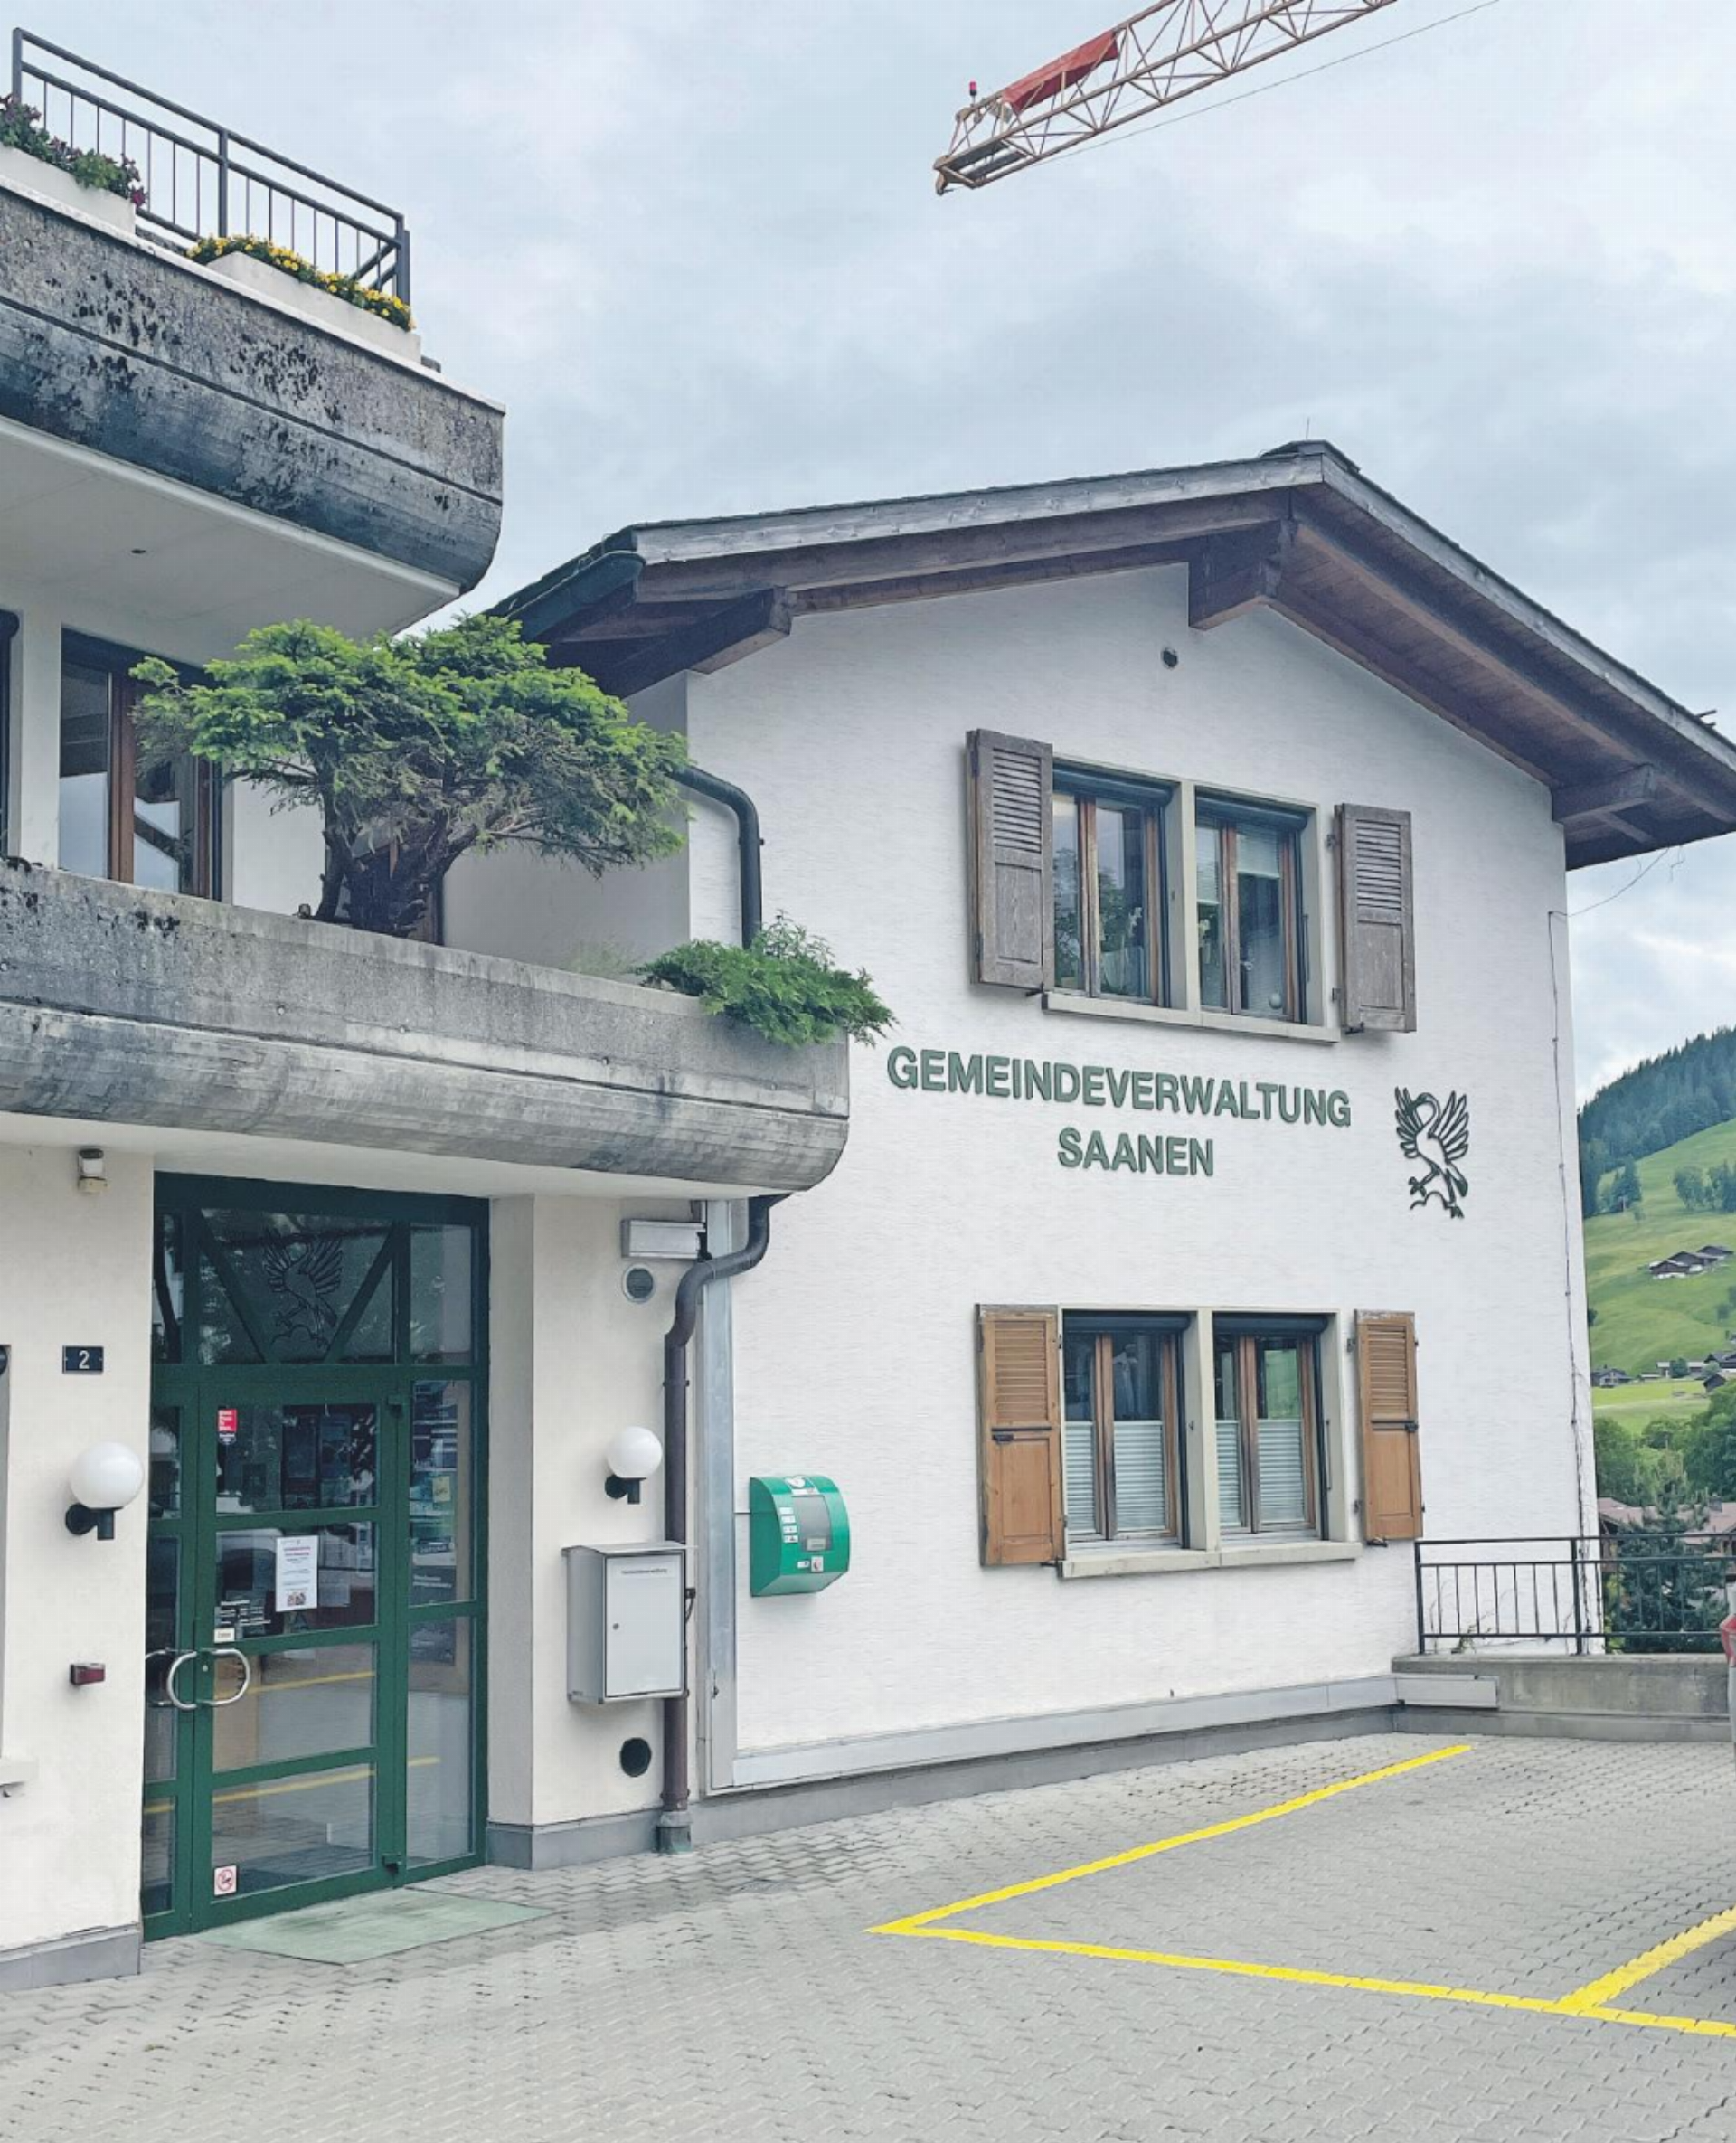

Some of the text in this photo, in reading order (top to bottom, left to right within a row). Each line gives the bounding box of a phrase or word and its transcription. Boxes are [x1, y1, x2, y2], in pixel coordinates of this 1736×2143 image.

[886, 1046, 1352, 1127] GEMEINDEVERWALTUNG
[1058, 1127, 1214, 1176] SAANEN
[78, 1350, 90, 1370] 2
